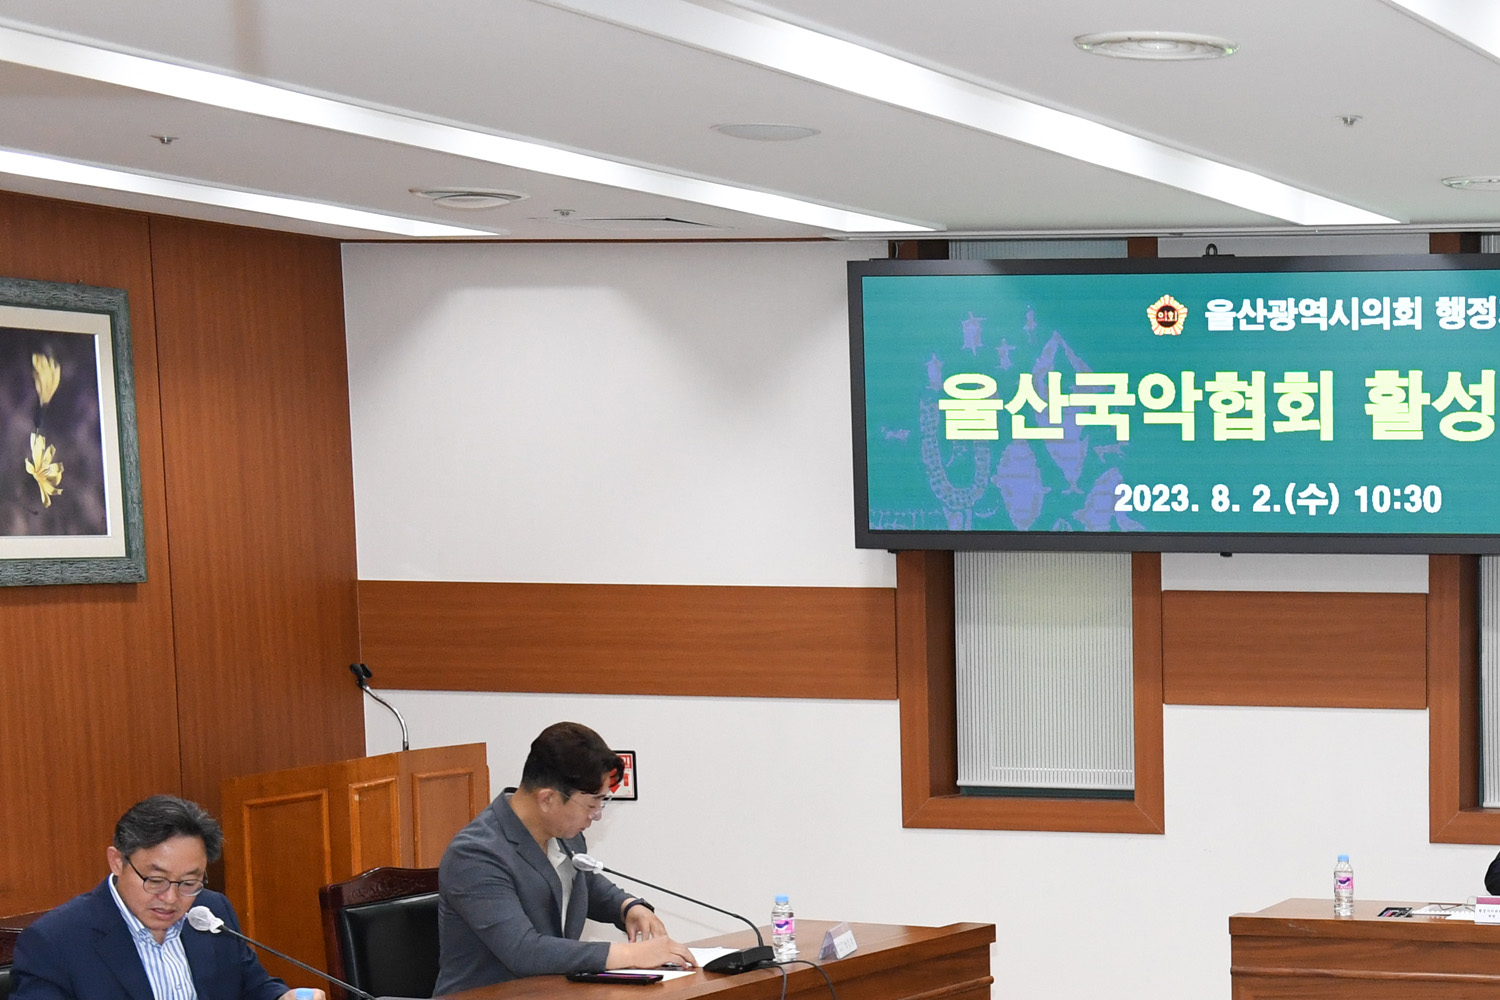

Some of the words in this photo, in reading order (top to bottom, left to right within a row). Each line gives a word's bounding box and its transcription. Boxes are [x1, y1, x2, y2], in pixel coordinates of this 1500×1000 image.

[1204, 296, 1422, 332] 울산광역시의회
[938, 370, 1334, 441] 울산국악협회
[1114, 483, 1199, 512] 2023.
[1211, 483, 1240, 513] 8.
[1252, 482, 1340, 516] 2.(수)
[1354, 484, 1442, 514] 10:30
